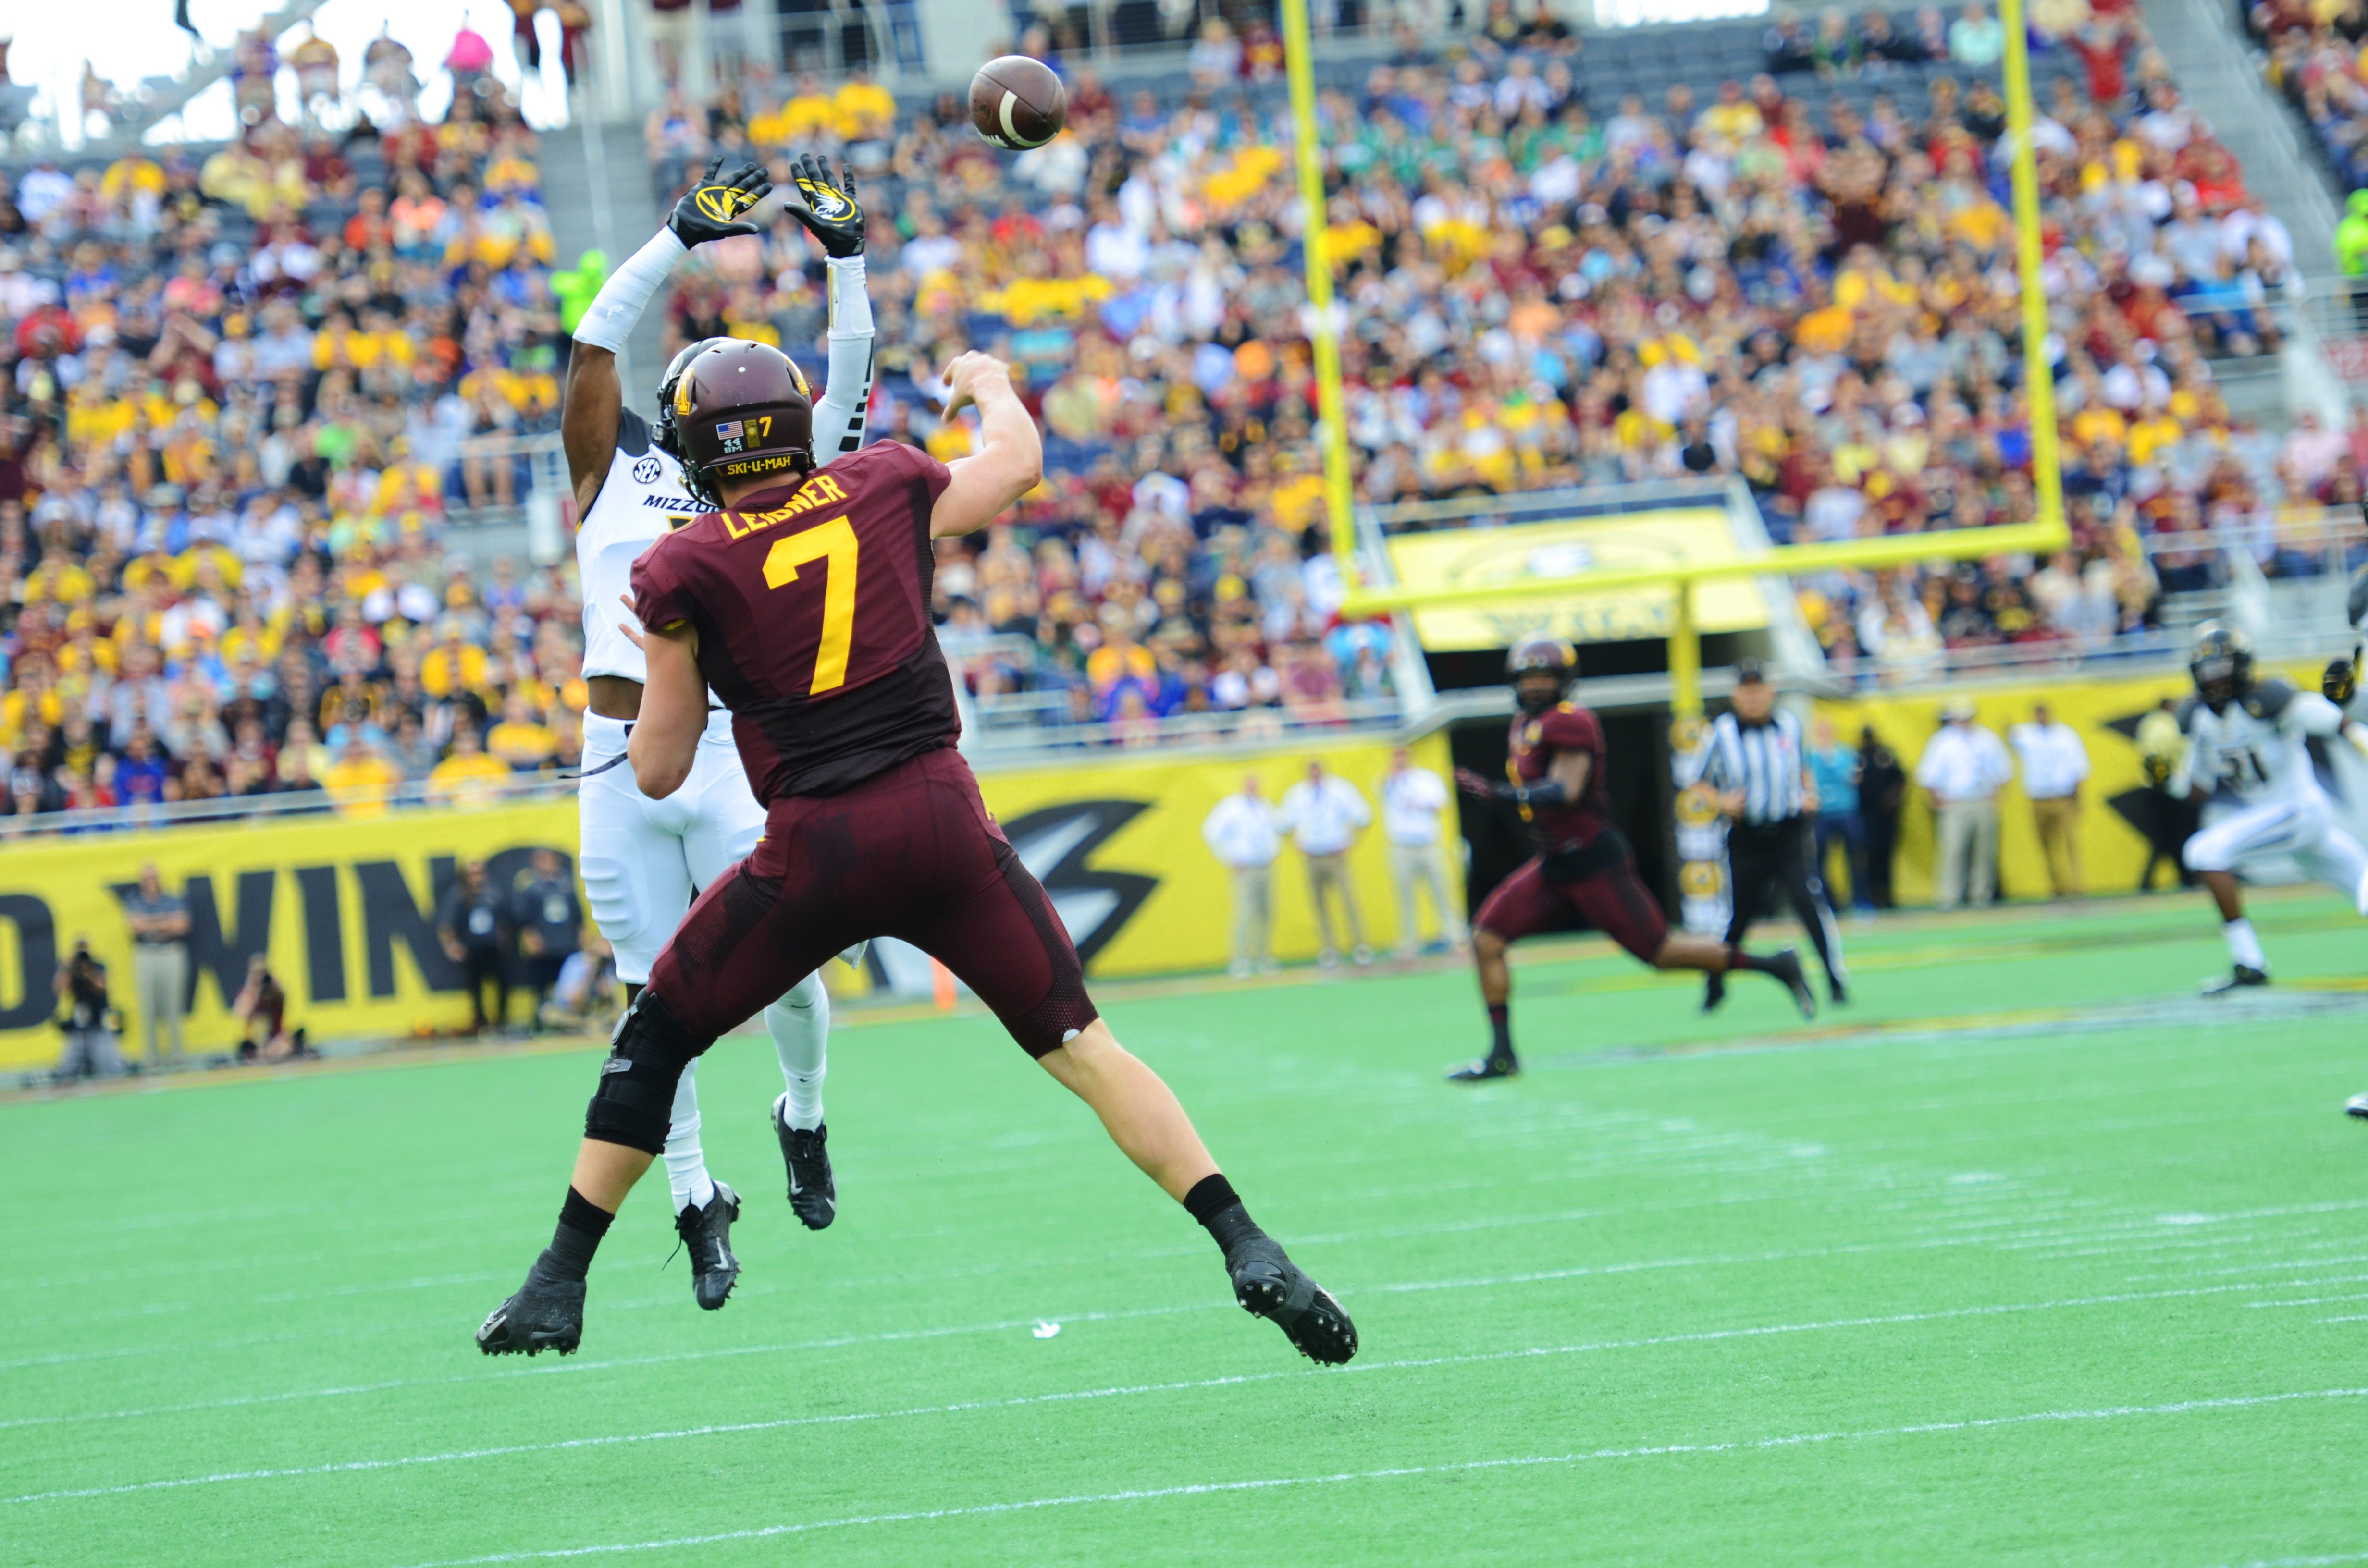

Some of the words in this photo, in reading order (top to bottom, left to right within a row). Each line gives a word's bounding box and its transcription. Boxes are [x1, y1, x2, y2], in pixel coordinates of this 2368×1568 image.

[759, 416, 772, 437] 7
[724, 438, 741, 447] 44
[724, 445, 743, 453] BM
[634, 458, 661, 483] SEC
[727, 456, 791, 475] SKI-U-MAH
[762, 515, 858, 695] 7
